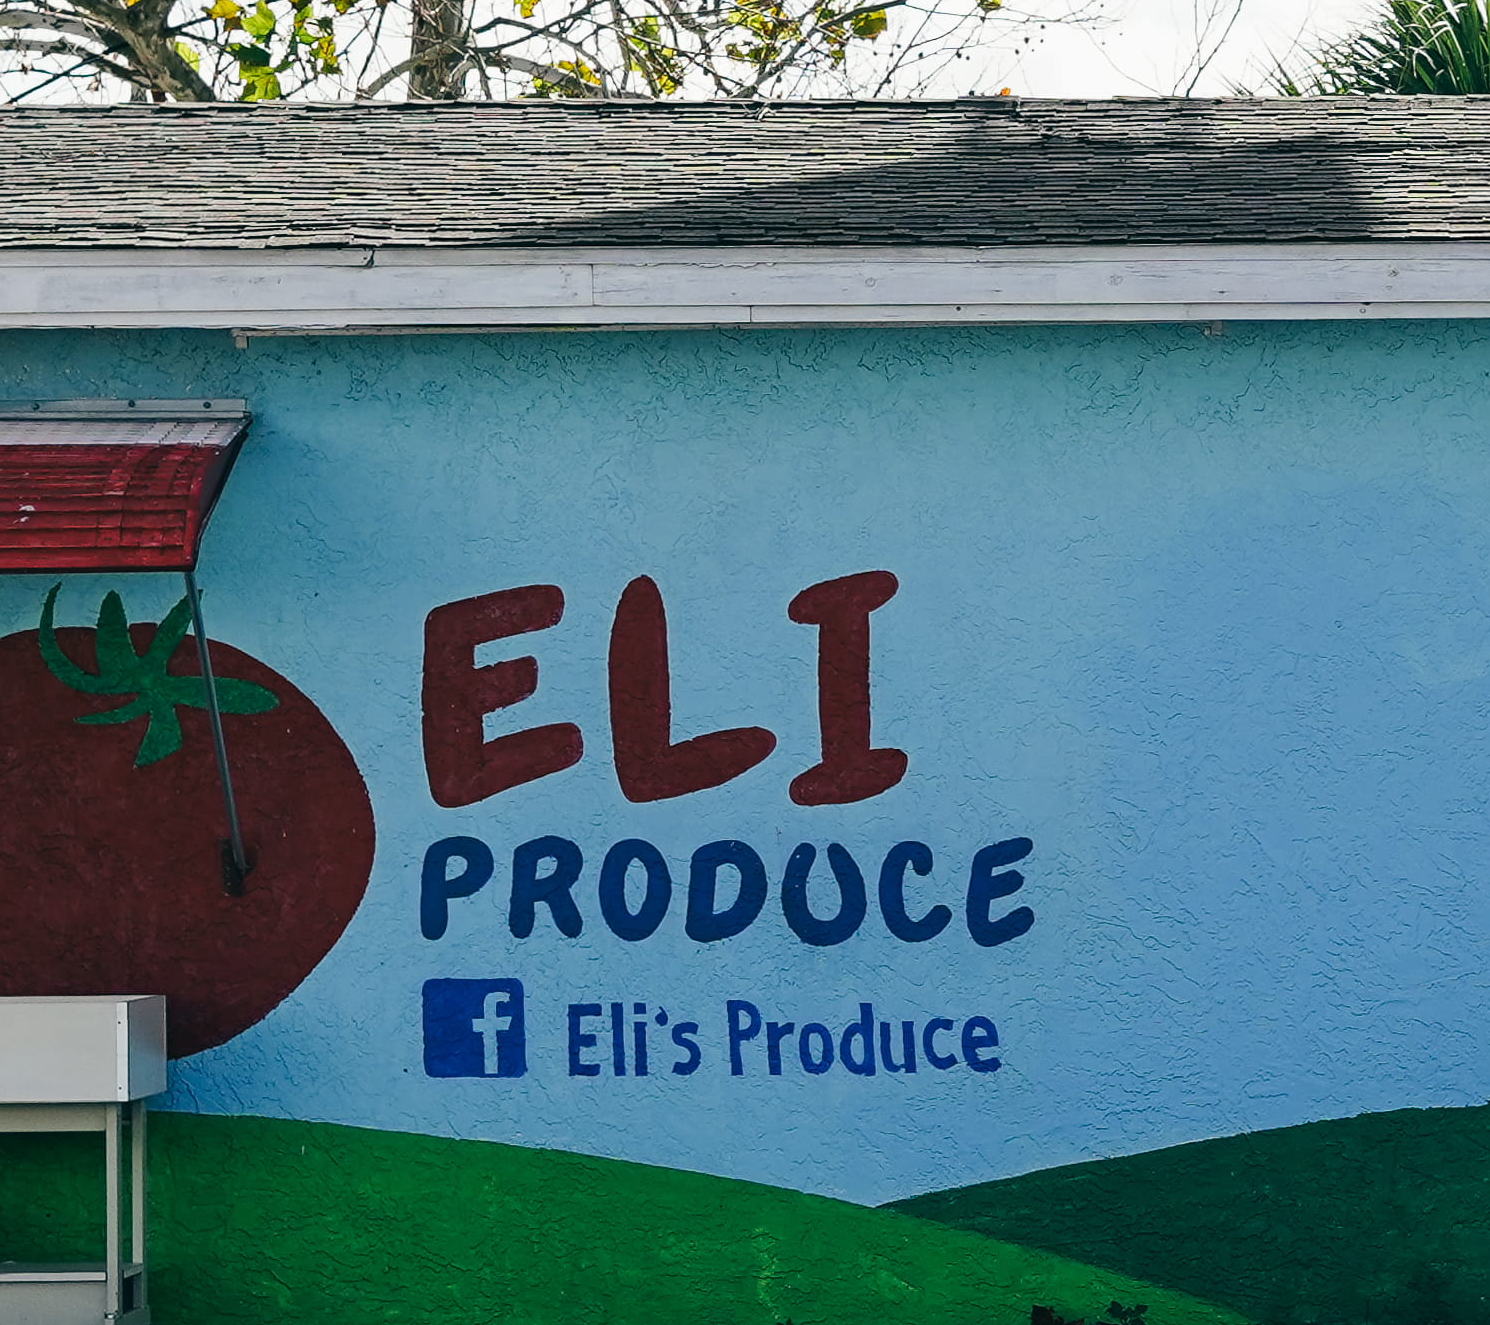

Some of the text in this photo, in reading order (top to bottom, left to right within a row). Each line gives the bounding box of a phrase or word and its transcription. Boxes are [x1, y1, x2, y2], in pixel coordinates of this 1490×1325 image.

[421, 570, 908, 808] ELI
[420, 835, 1035, 947] PRODUCE
[567, 1002, 701, 1076] Eli's
[727, 999, 1002, 1076] Produce
